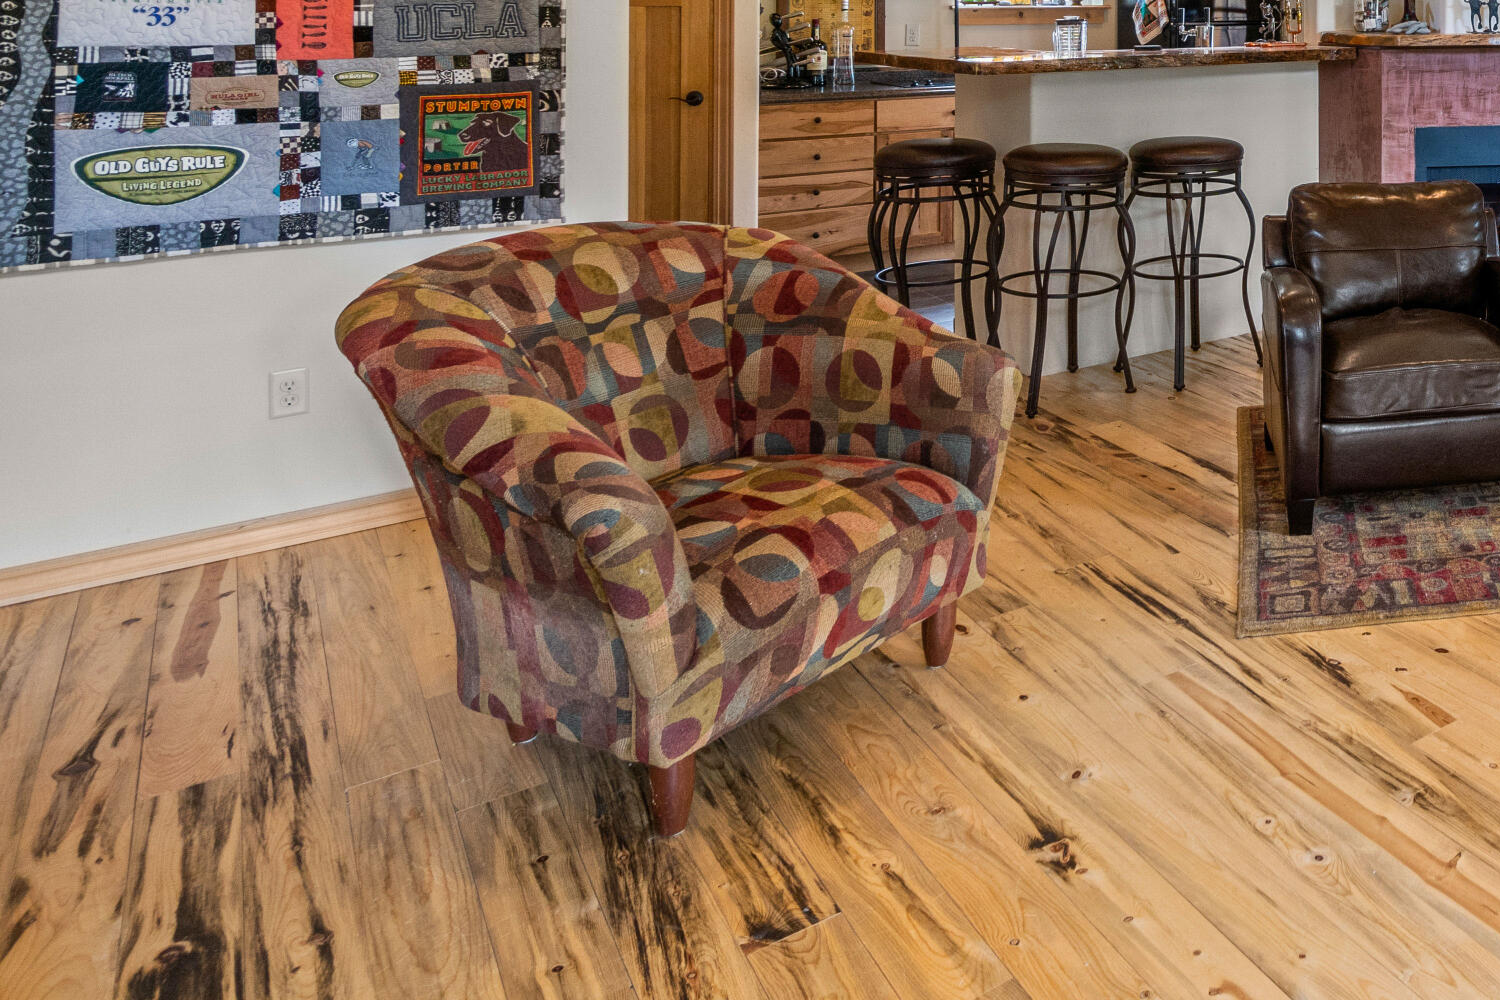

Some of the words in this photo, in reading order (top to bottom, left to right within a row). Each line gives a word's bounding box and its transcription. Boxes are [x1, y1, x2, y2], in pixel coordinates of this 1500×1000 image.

[395, 1, 527, 42] UCLA
[425, 98, 527, 113] STUMPTOWN
[94, 160, 132, 175] OLD
[181, 156, 226, 171] RULE
[423, 160, 479, 172] PORTER
[160, 179, 203, 190] LEGEND
[422, 175, 461, 184] LUCKY
[465, 170, 528, 181] LABRADOR
[422, 182, 473, 193] BREWING
[476, 178, 528, 189] COMPANY
